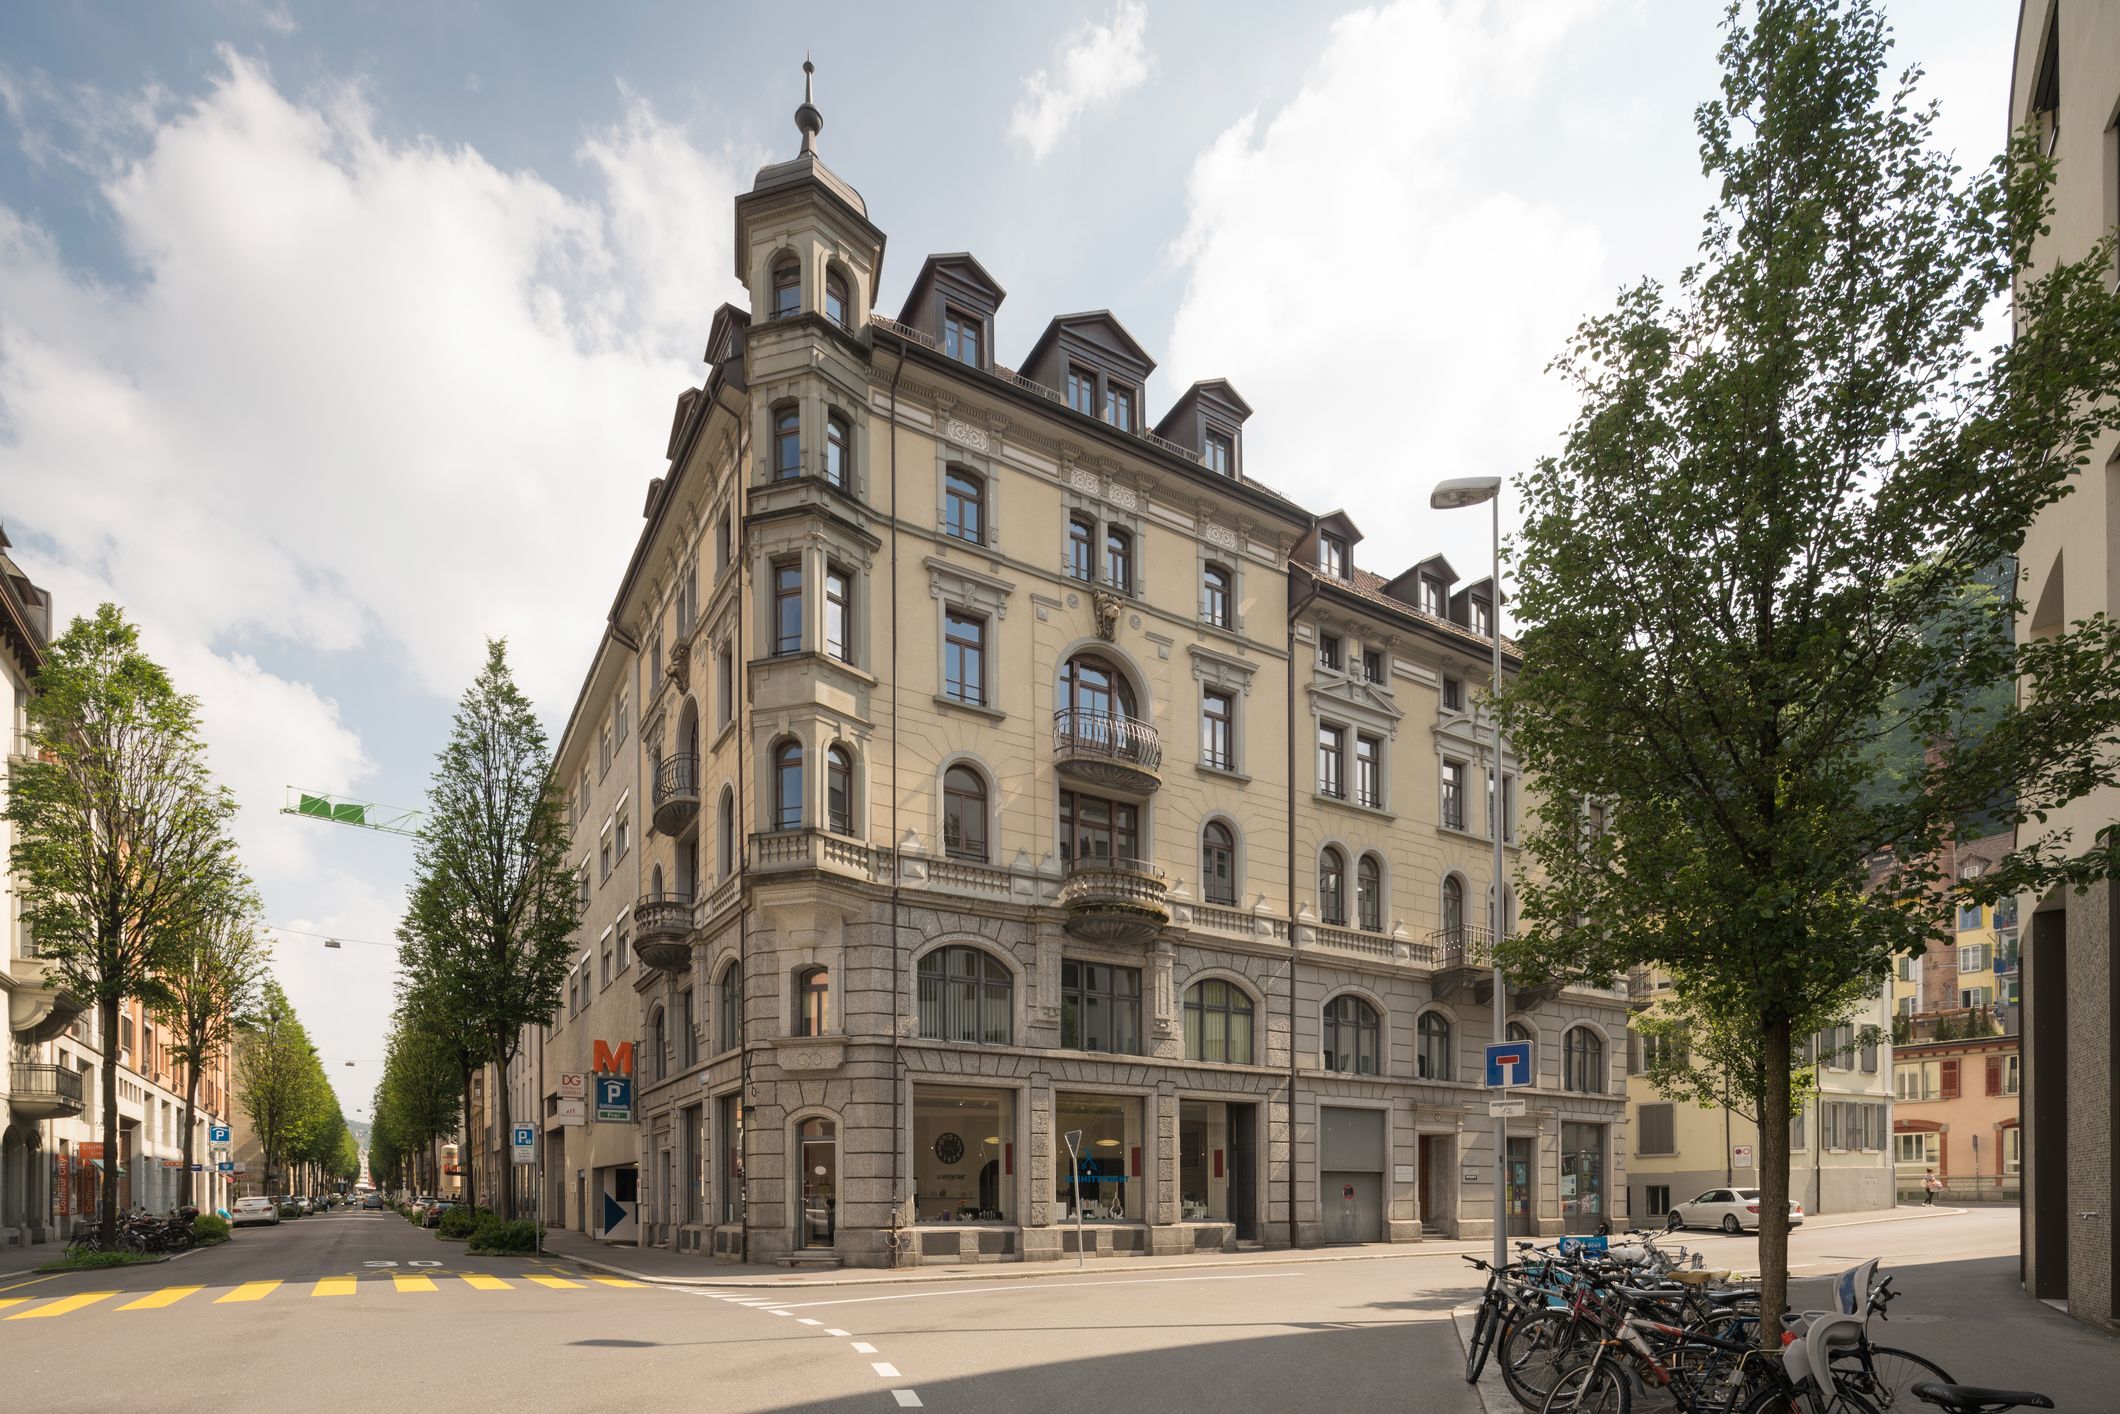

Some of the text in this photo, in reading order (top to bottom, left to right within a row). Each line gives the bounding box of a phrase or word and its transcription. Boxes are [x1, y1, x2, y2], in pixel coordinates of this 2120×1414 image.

[594, 1040, 632, 1073] M
[562, 1075, 581, 1086] DG
[608, 1085, 621, 1103] P
[216, 1130, 225, 1140] P
[518, 1131, 527, 1144] P
